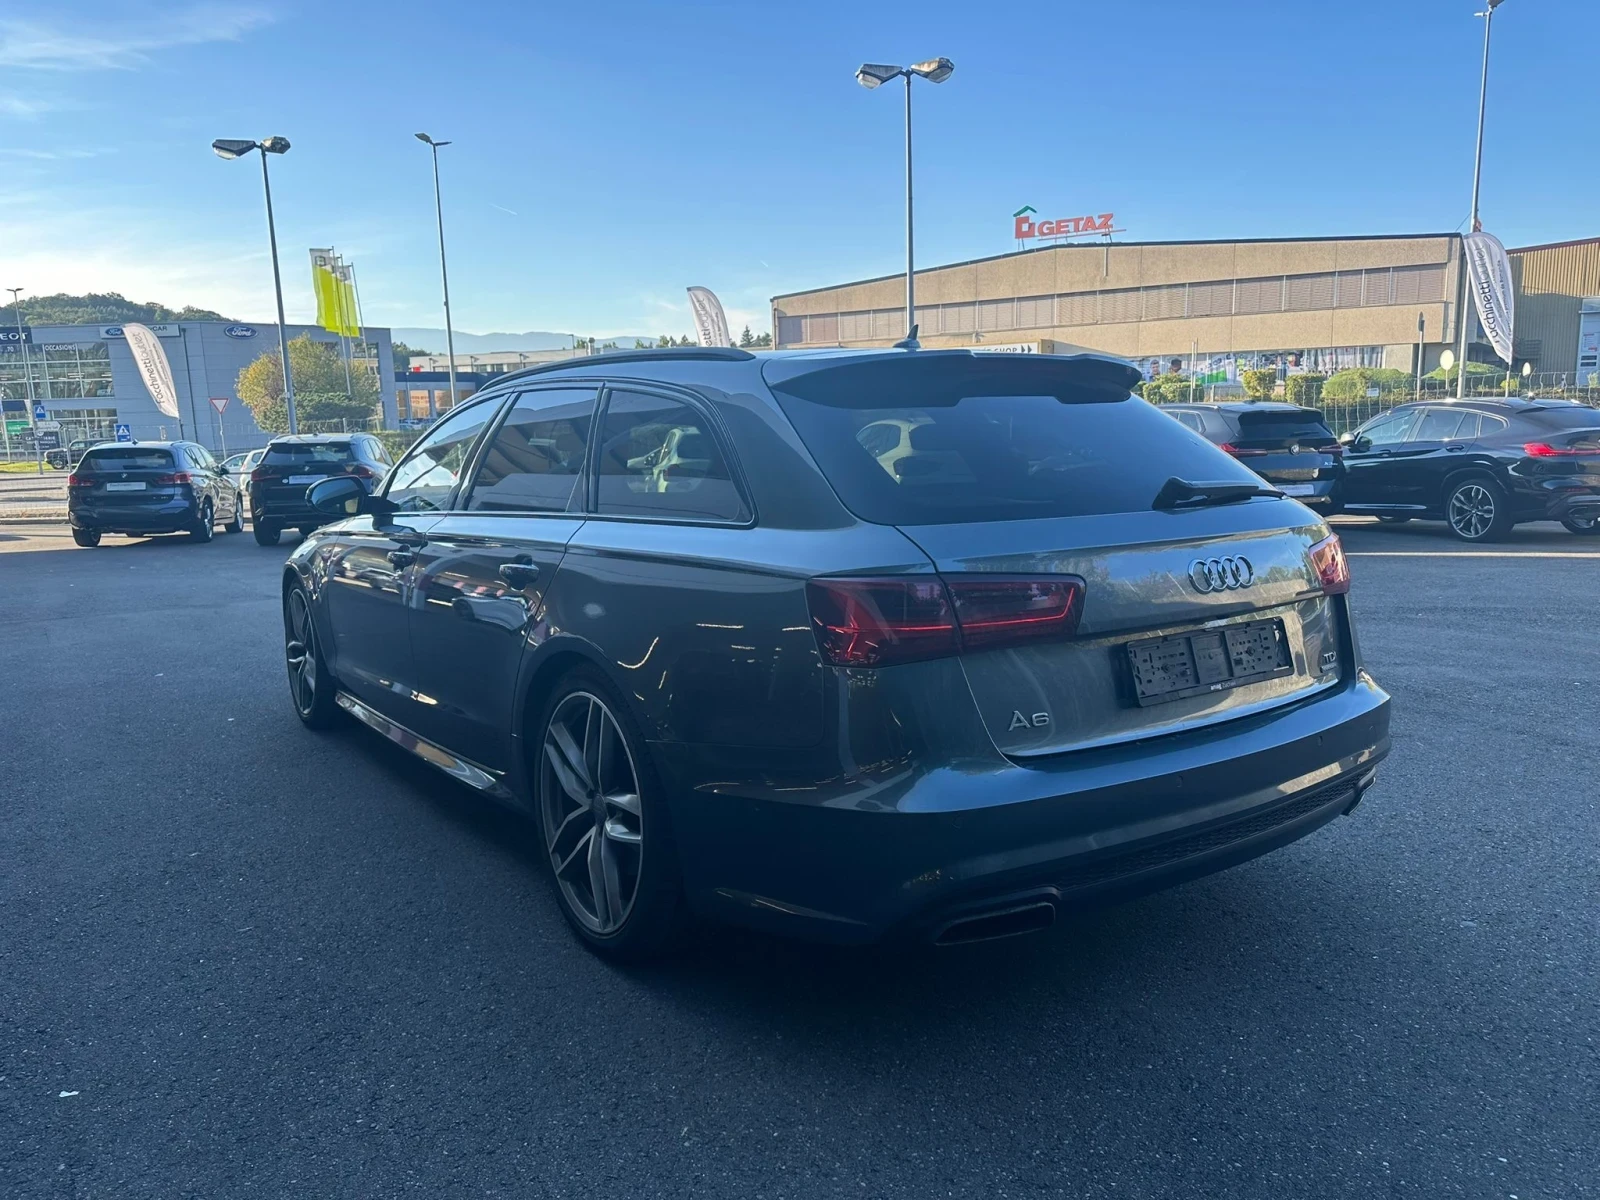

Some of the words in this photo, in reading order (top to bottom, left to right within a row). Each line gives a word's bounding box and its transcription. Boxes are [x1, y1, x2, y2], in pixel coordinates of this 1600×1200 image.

[1037, 213, 1114, 237] GETAZ
[231, 326, 252, 337] Ford
[1008, 710, 1050, 732] A6
